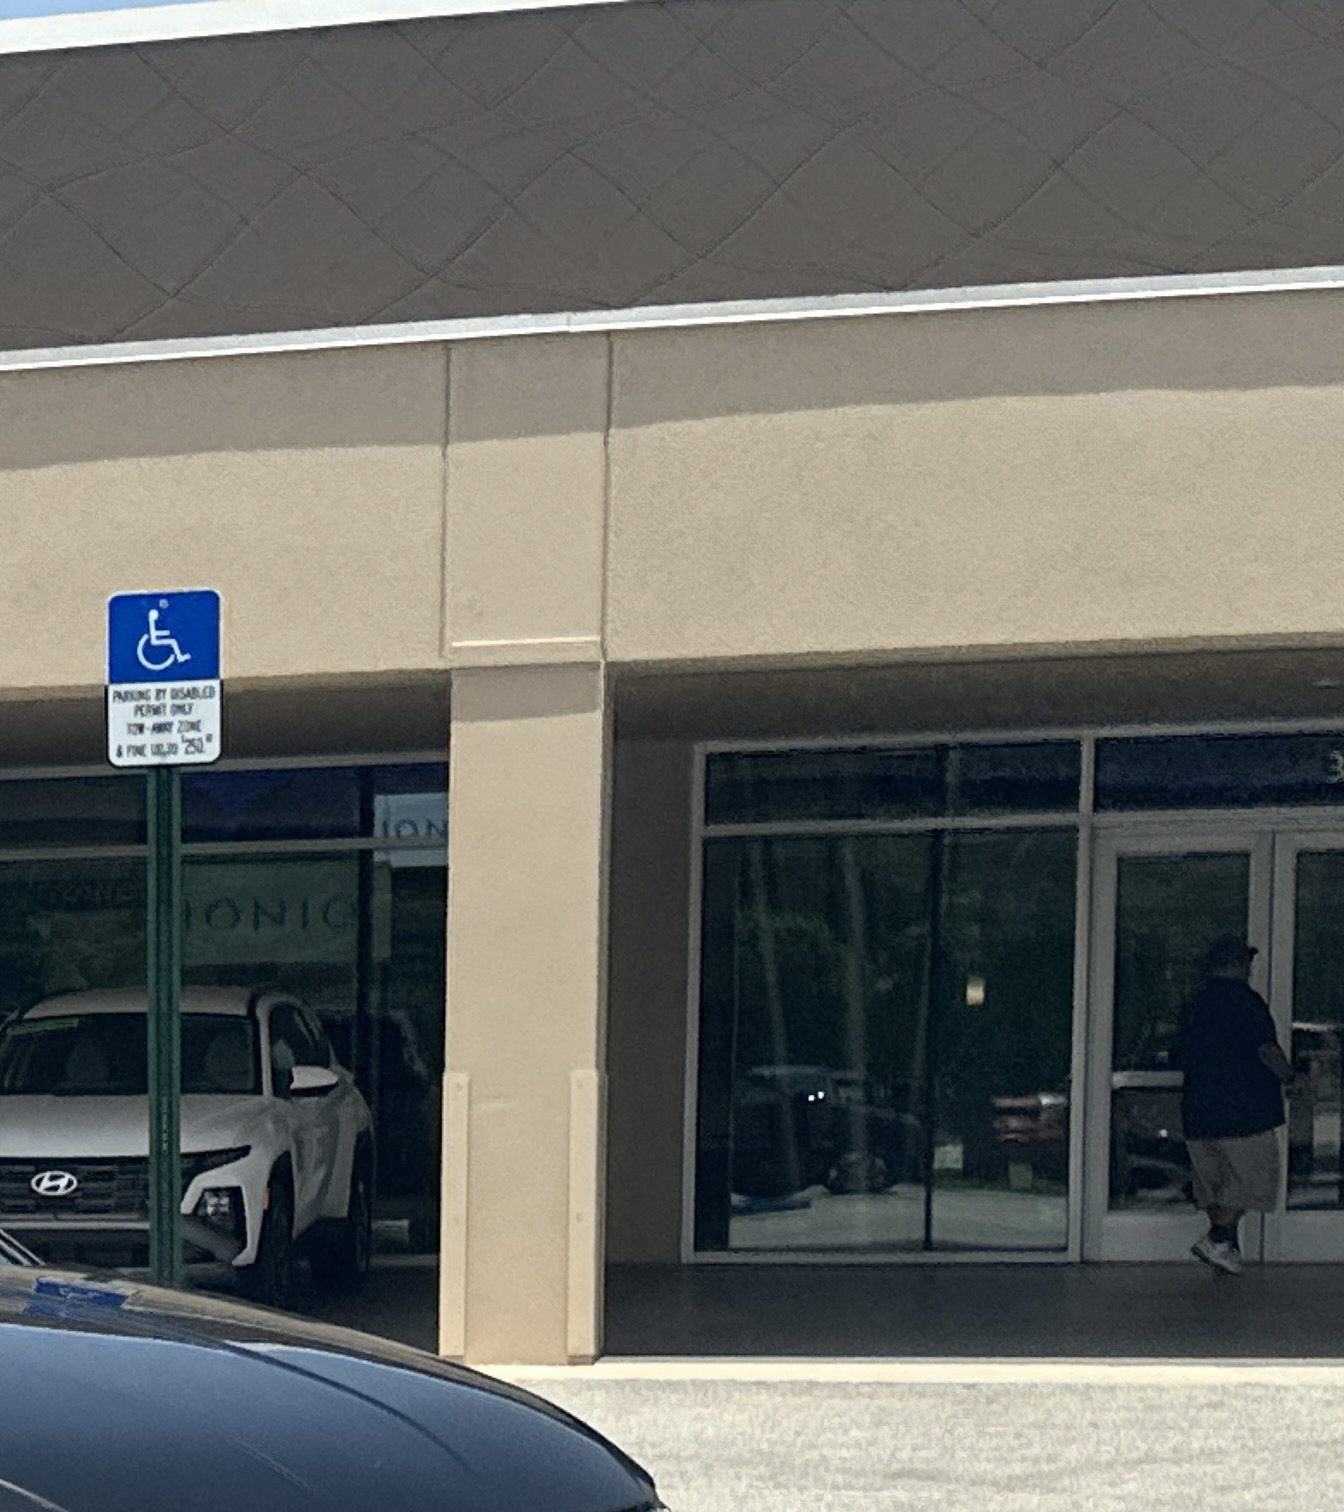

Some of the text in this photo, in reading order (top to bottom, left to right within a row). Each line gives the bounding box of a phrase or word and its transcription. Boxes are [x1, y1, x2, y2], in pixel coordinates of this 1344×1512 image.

[113, 685, 215, 703] PARKING BY DISABLED
[134, 703, 193, 717] PERMIT ONLY
